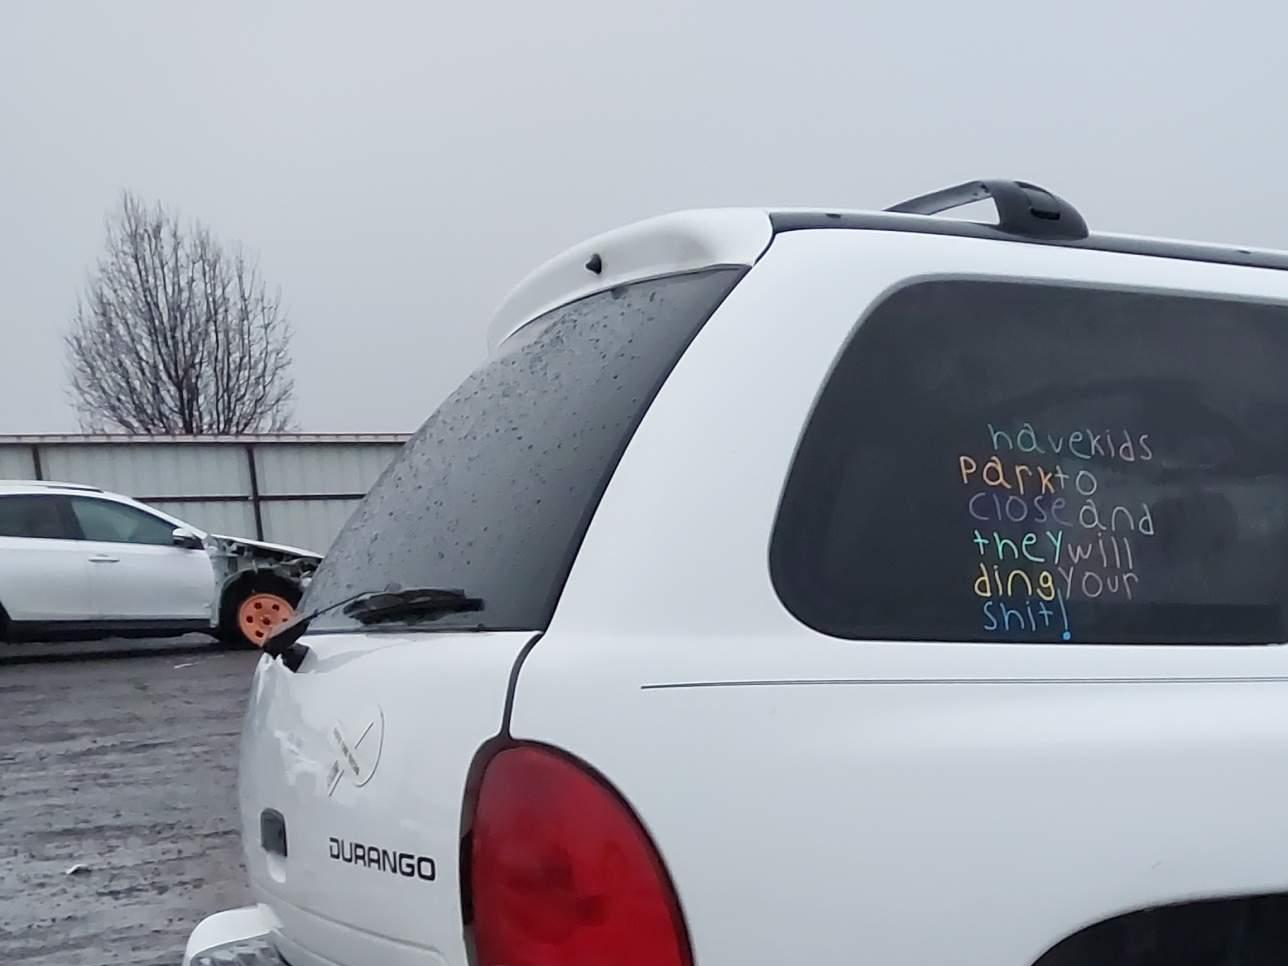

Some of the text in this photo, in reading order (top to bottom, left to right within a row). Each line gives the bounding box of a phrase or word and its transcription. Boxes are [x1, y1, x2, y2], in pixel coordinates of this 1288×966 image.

[987, 423, 1152, 461] have kids
[1053, 465, 1097, 495] to
[1079, 499, 1154, 535] and
[972, 530, 1133, 569] they will
[974, 563, 1139, 600] ding your
[329, 837, 436, 881] DURANGO
